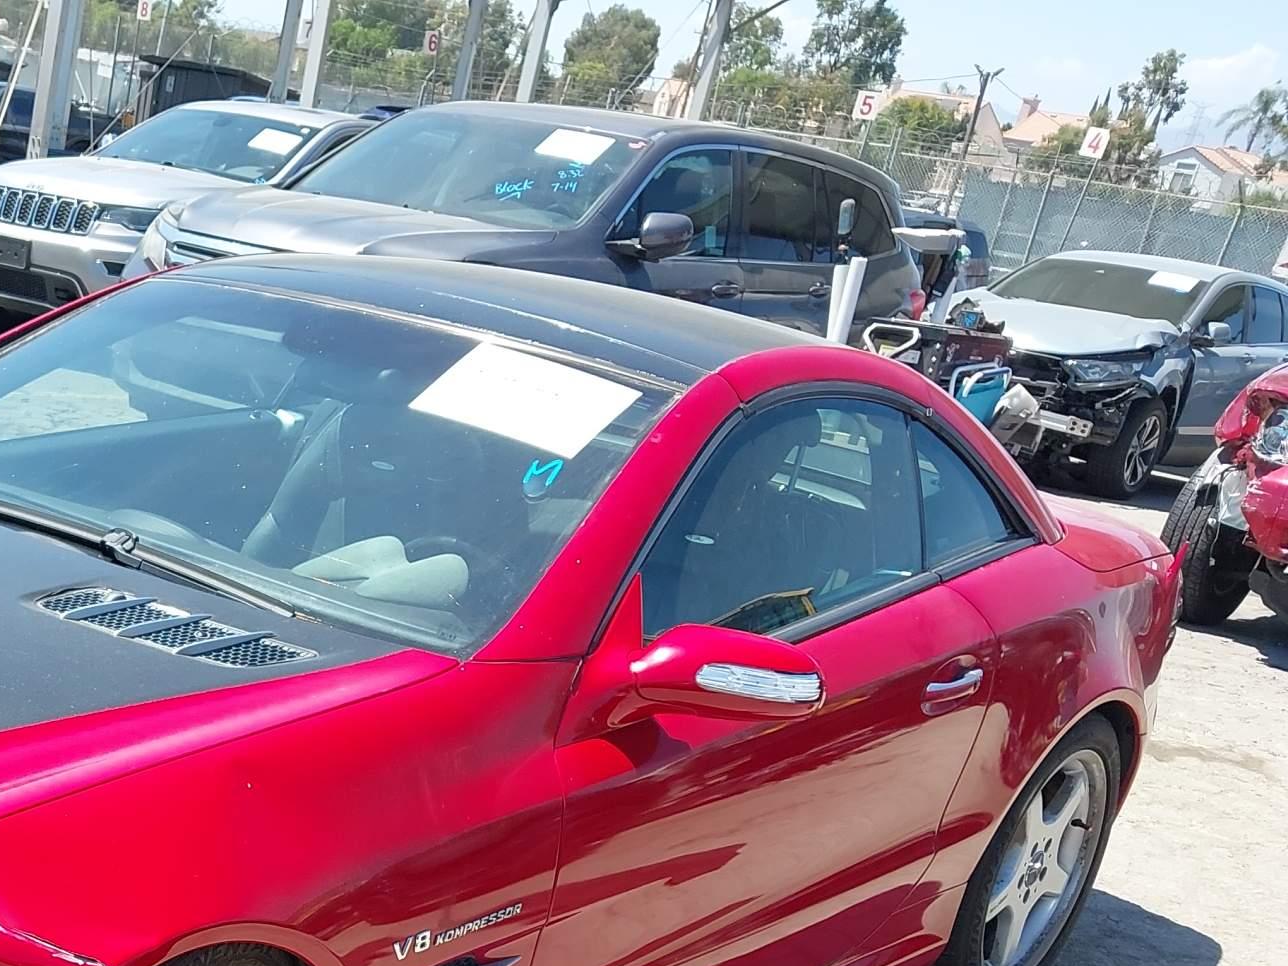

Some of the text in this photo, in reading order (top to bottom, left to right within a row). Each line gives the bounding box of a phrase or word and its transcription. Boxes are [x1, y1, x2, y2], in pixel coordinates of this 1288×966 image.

[140, 1, 148, 17] 8
[304, 20, 313, 39] 7
[428, 33, 437, 52] 6
[859, 95, 875, 116] 5
[1087, 131, 1103, 154] 4
[393, 902, 523, 961] V8 KOMPRESSOR
